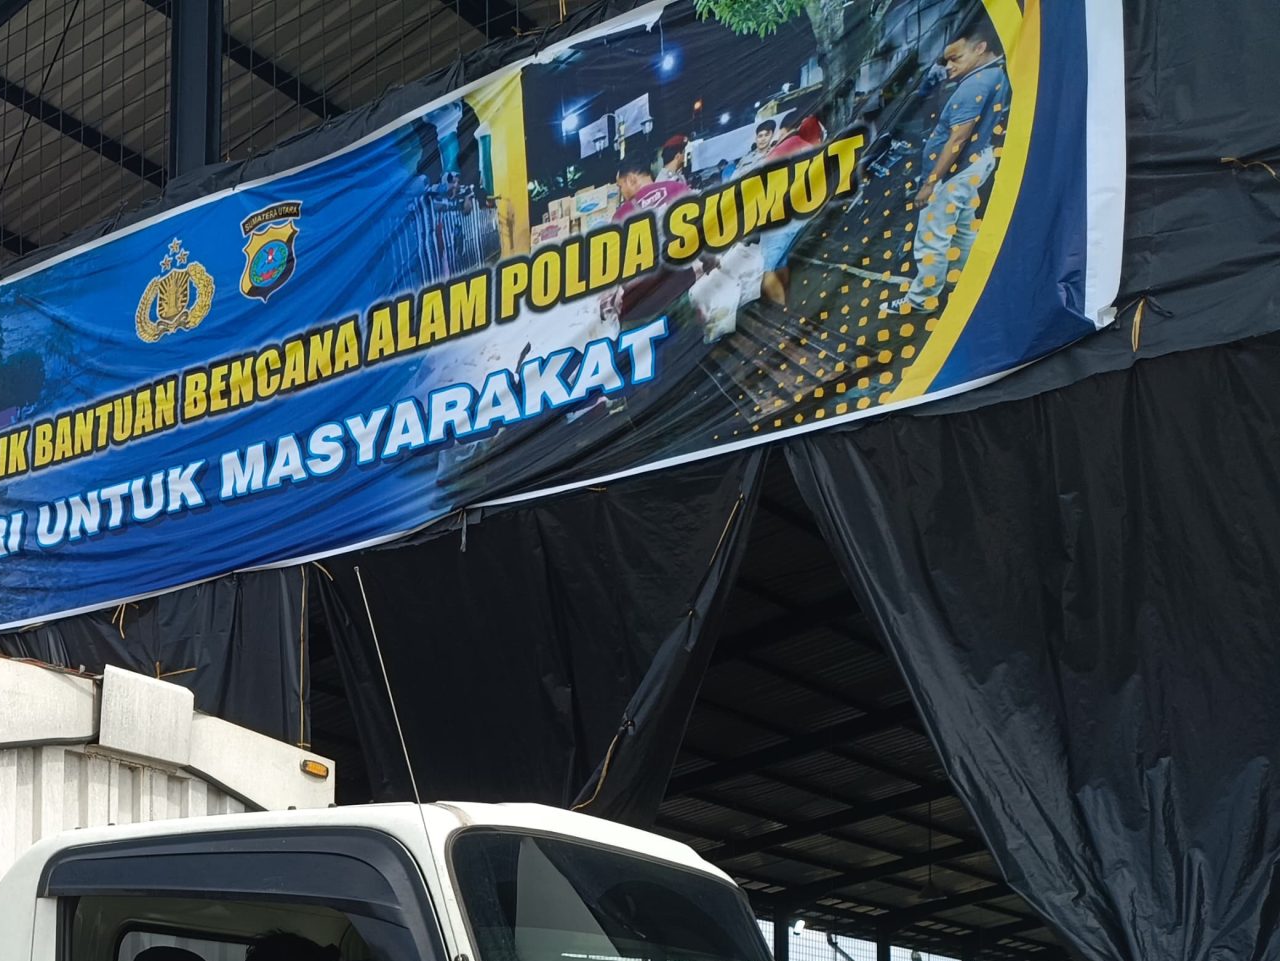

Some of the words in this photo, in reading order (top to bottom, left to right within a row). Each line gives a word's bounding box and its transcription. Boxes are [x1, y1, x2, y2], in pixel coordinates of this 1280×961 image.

[32, 379, 175, 467] BANTUAN
[183, 328, 360, 420] BENCANA
[366, 274, 487, 362] ALAM
[501, 223, 656, 318] POLDA
[668, 134, 864, 260] SUMUT
[245, 208, 277, 231] SUMATERA
[278, 206, 297, 215] UTARA
[38, 462, 205, 544] UNTUK
[221, 317, 669, 494] MASYARAKAT
